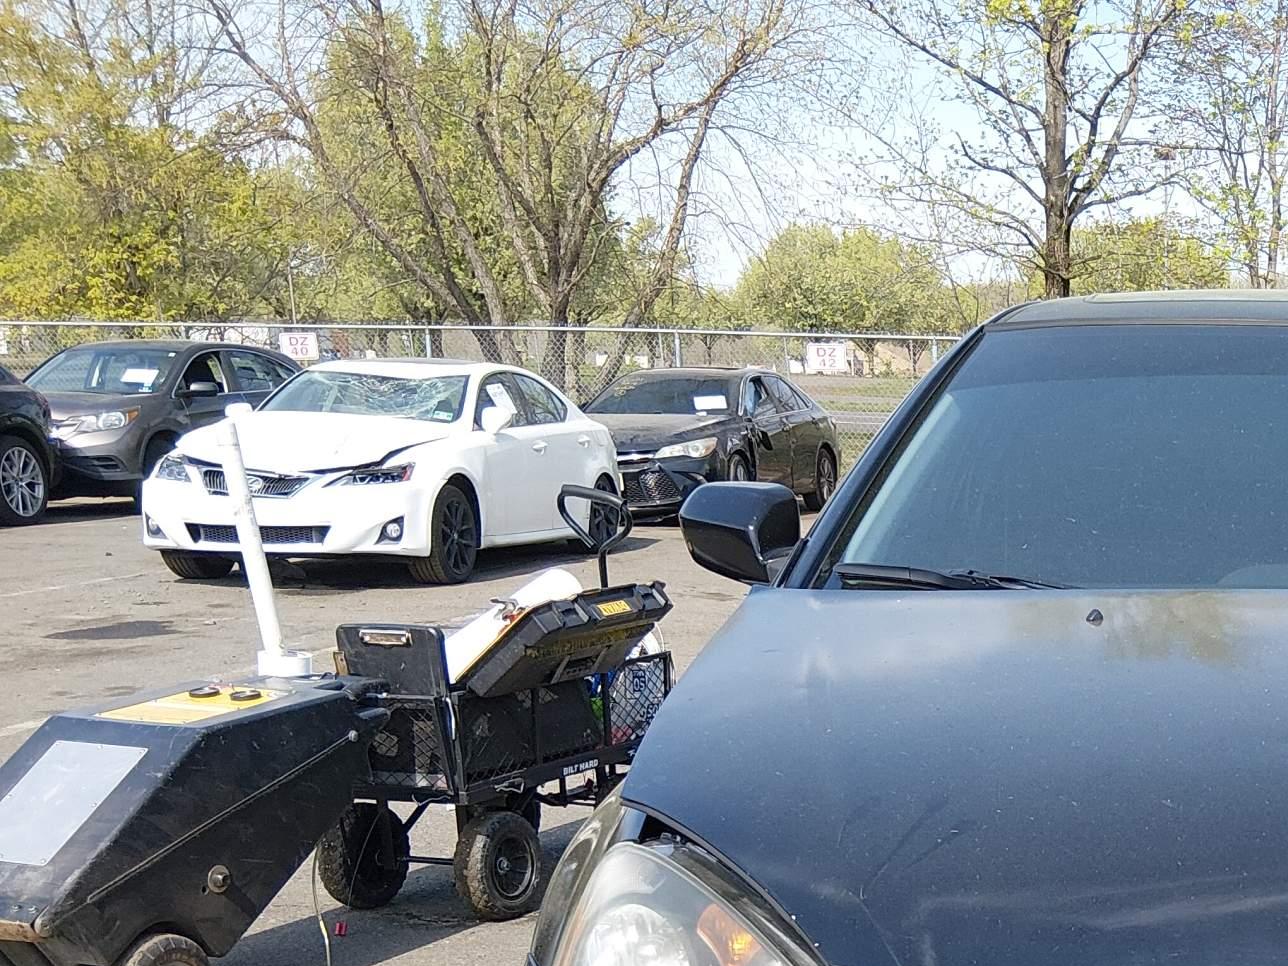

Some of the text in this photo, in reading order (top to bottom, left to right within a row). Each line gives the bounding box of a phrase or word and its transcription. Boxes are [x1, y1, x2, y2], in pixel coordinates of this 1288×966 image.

[289, 336, 309, 346] DZ
[291, 347, 308, 356] 40
[816, 347, 837, 357] DZ
